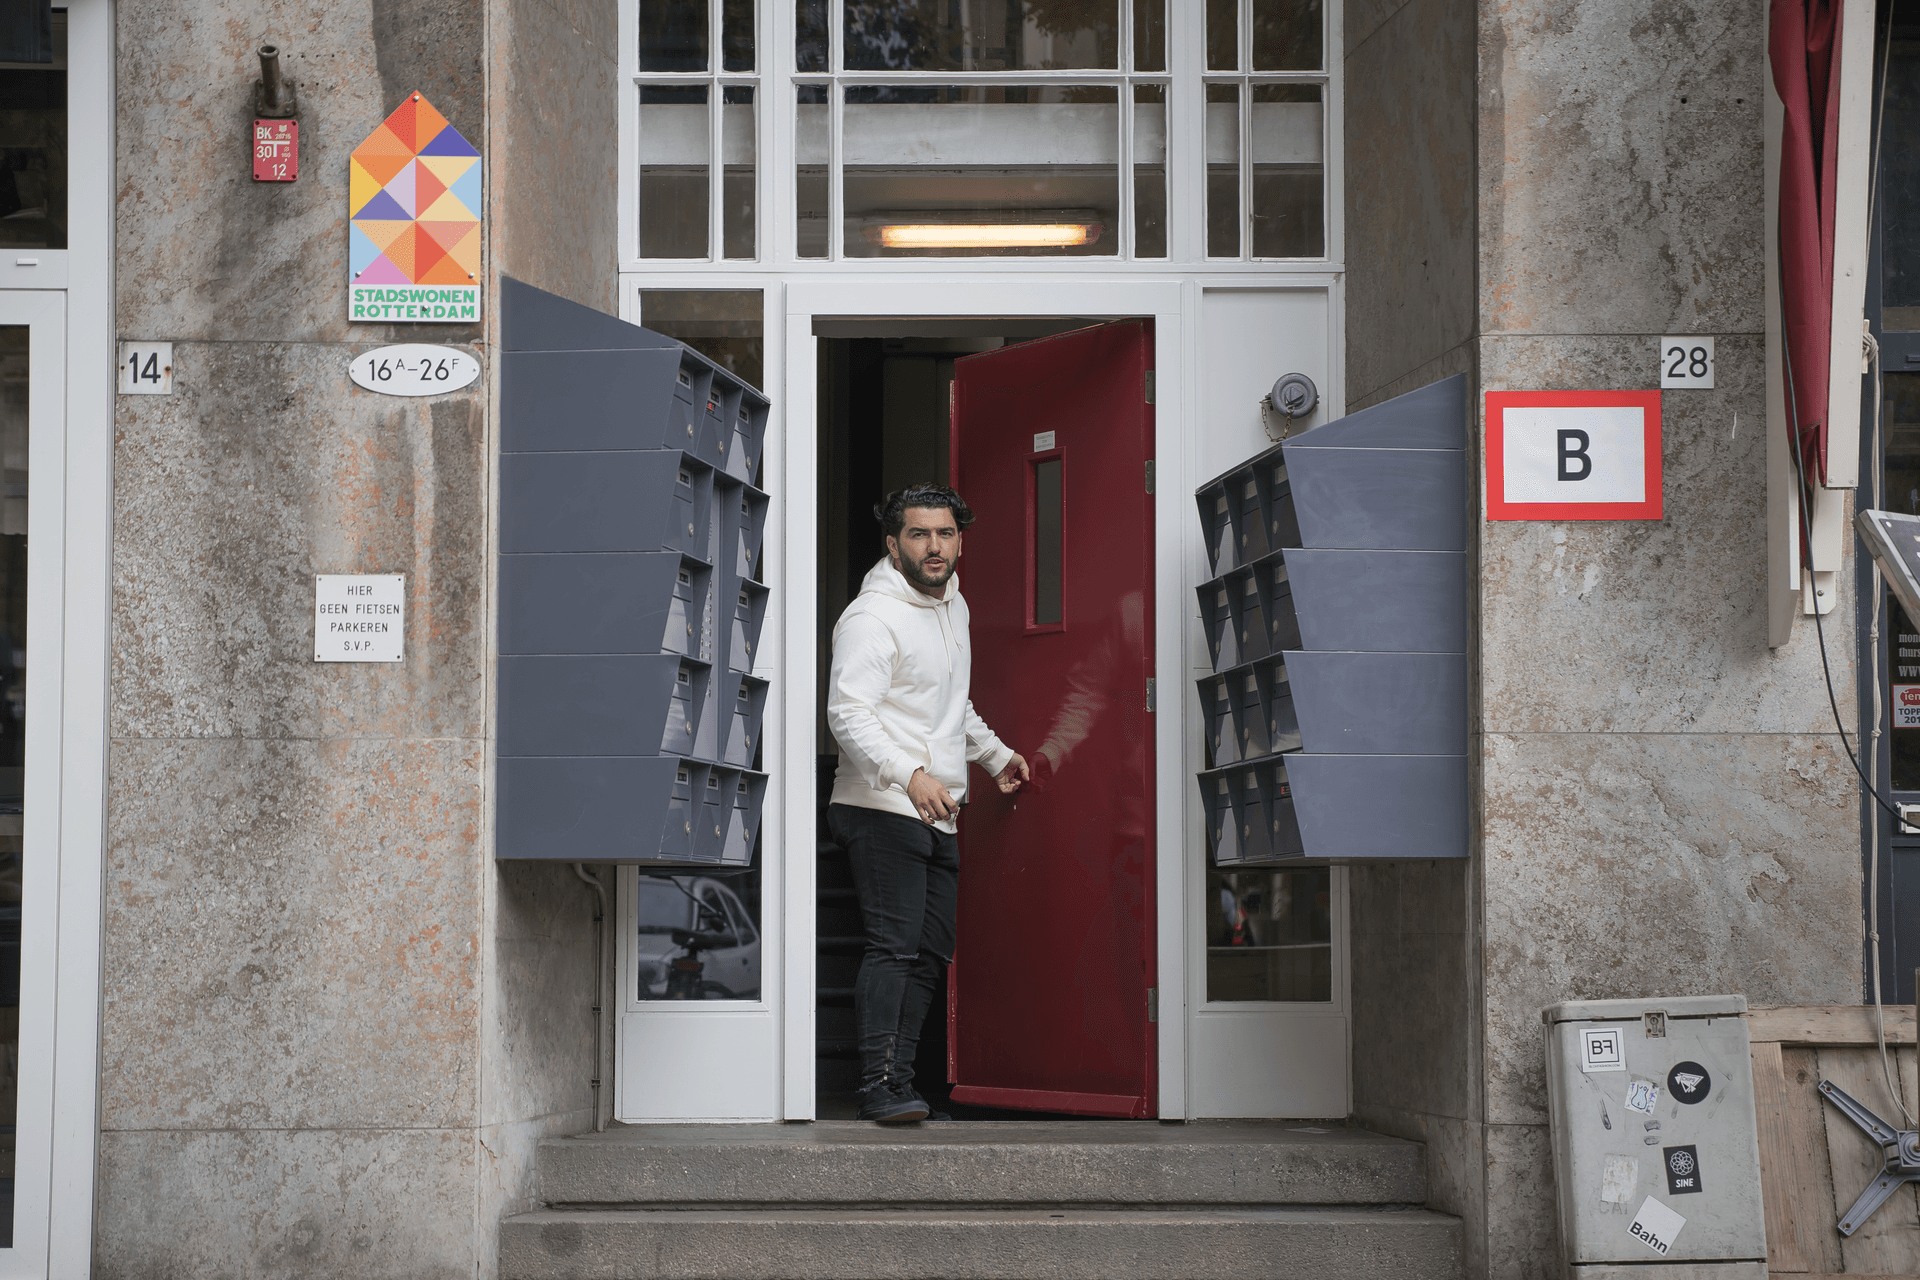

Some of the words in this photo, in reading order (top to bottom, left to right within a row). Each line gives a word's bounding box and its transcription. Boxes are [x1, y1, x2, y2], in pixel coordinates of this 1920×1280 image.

[256, 126, 272, 139] BK
[354, 289, 475, 303] STADSWONEN
[354, 304, 475, 318] ROTTERDAM
[129, 352, 161, 384] 14
[1667, 346, 1708, 378] 28
[1557, 429, 1592, 481] B
[347, 585, 373, 596] HIER
[319, 603, 348, 614] GEEN
[355, 604, 400, 614] FIETSEN
[330, 622, 388, 633] PARKEREN
[1899, 633, 1920, 643] mon
[343, 640, 375, 651] S.V.P.
[1675, 1178, 1694, 1188] SINE
[1630, 1221, 1668, 1253] Bahn
